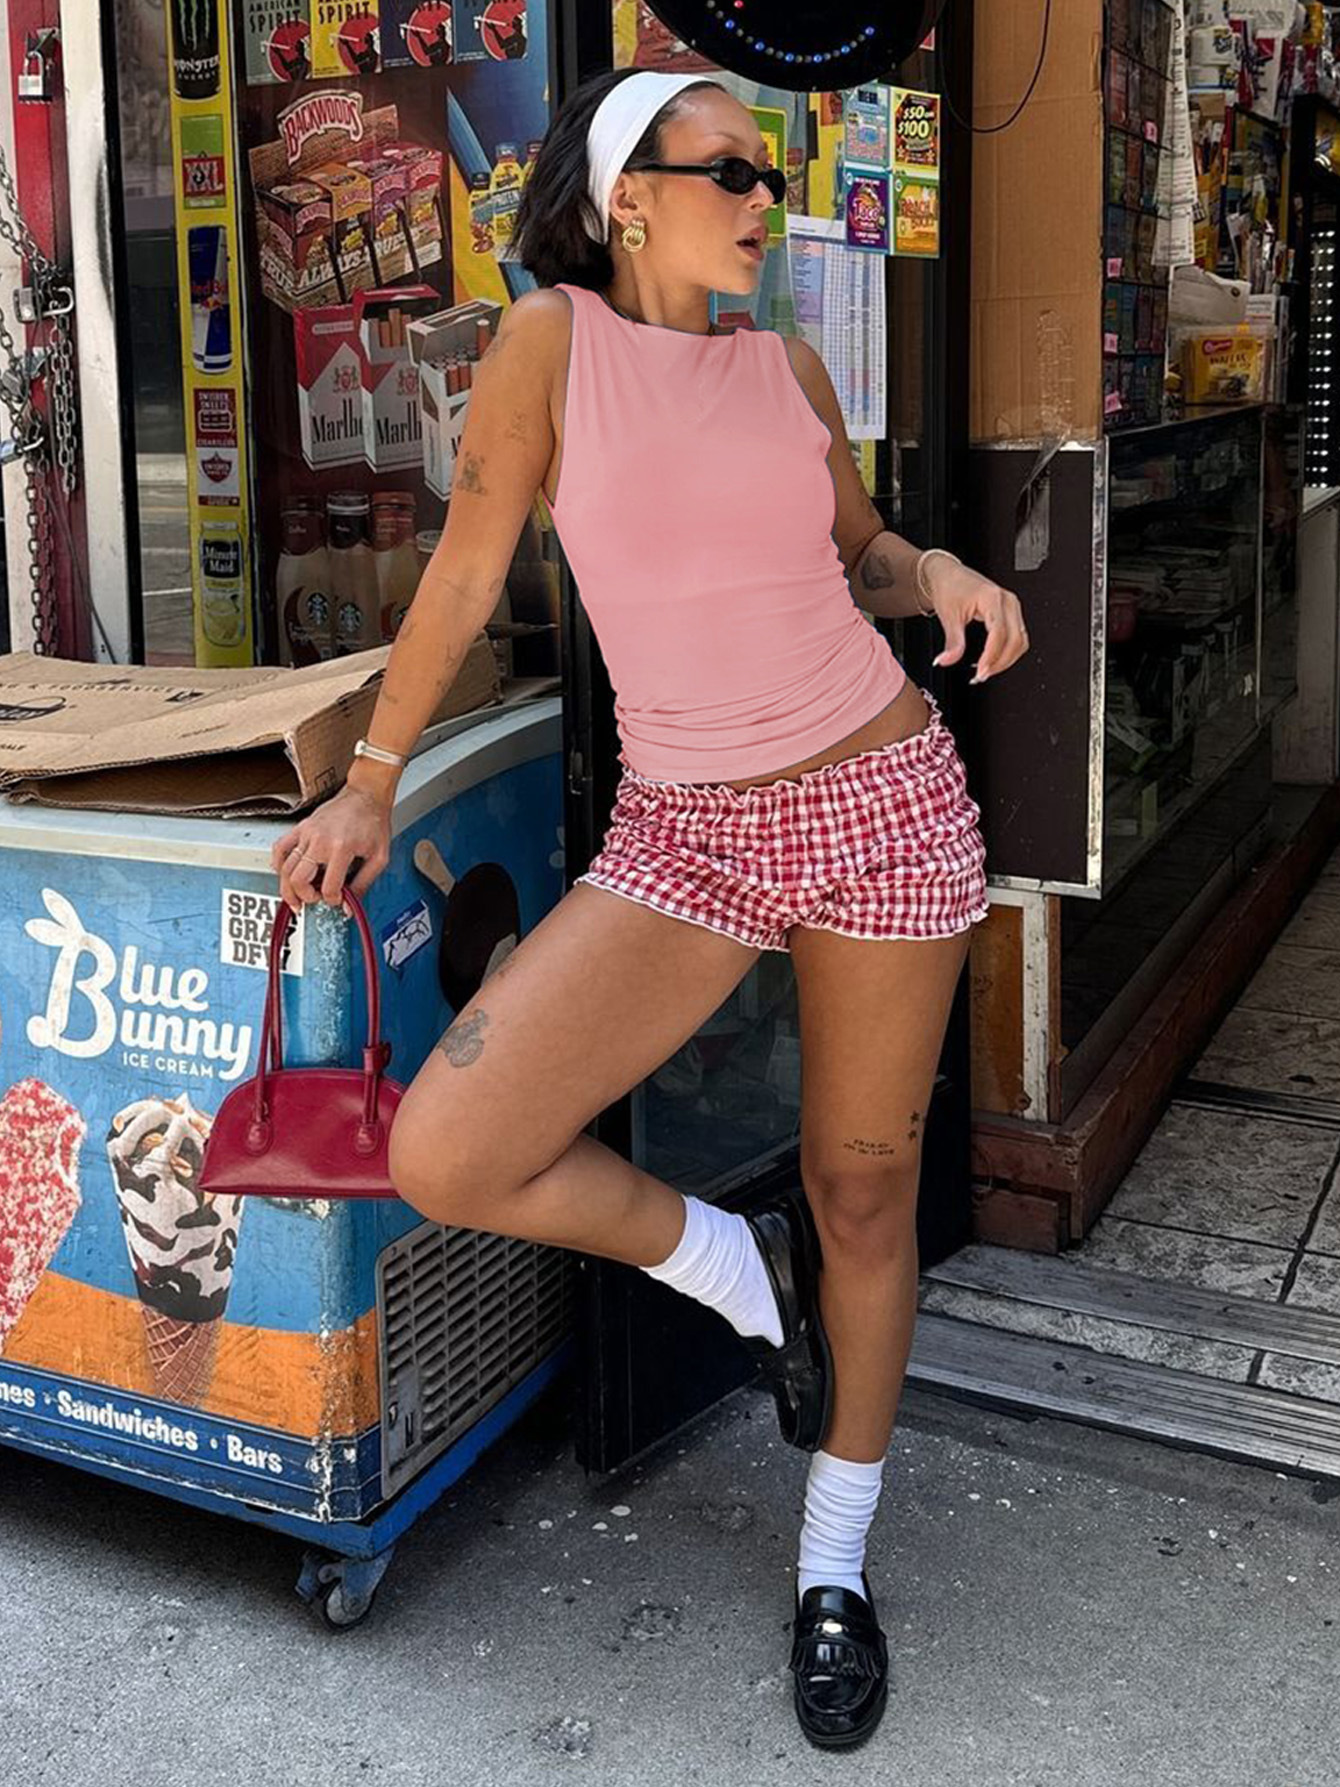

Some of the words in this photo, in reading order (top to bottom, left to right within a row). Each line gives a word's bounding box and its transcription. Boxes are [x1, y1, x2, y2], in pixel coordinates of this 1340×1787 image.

[249, 9, 301, 32] SPIRIT
[318, 1, 370, 24] SPIRIT
[903, 106, 925, 119] $50
[285, 97, 362, 158] BACKWOODS
[205, 545, 238, 560] Minute
[209, 560, 234, 574] Maid
[24, 888, 209, 1058] Blue
[123, 1053, 150, 1069] ICE
[154, 1056, 214, 1078] CREAM
[57, 1390, 198, 1451] Sandwiches
[227, 1435, 283, 1474] Bars
